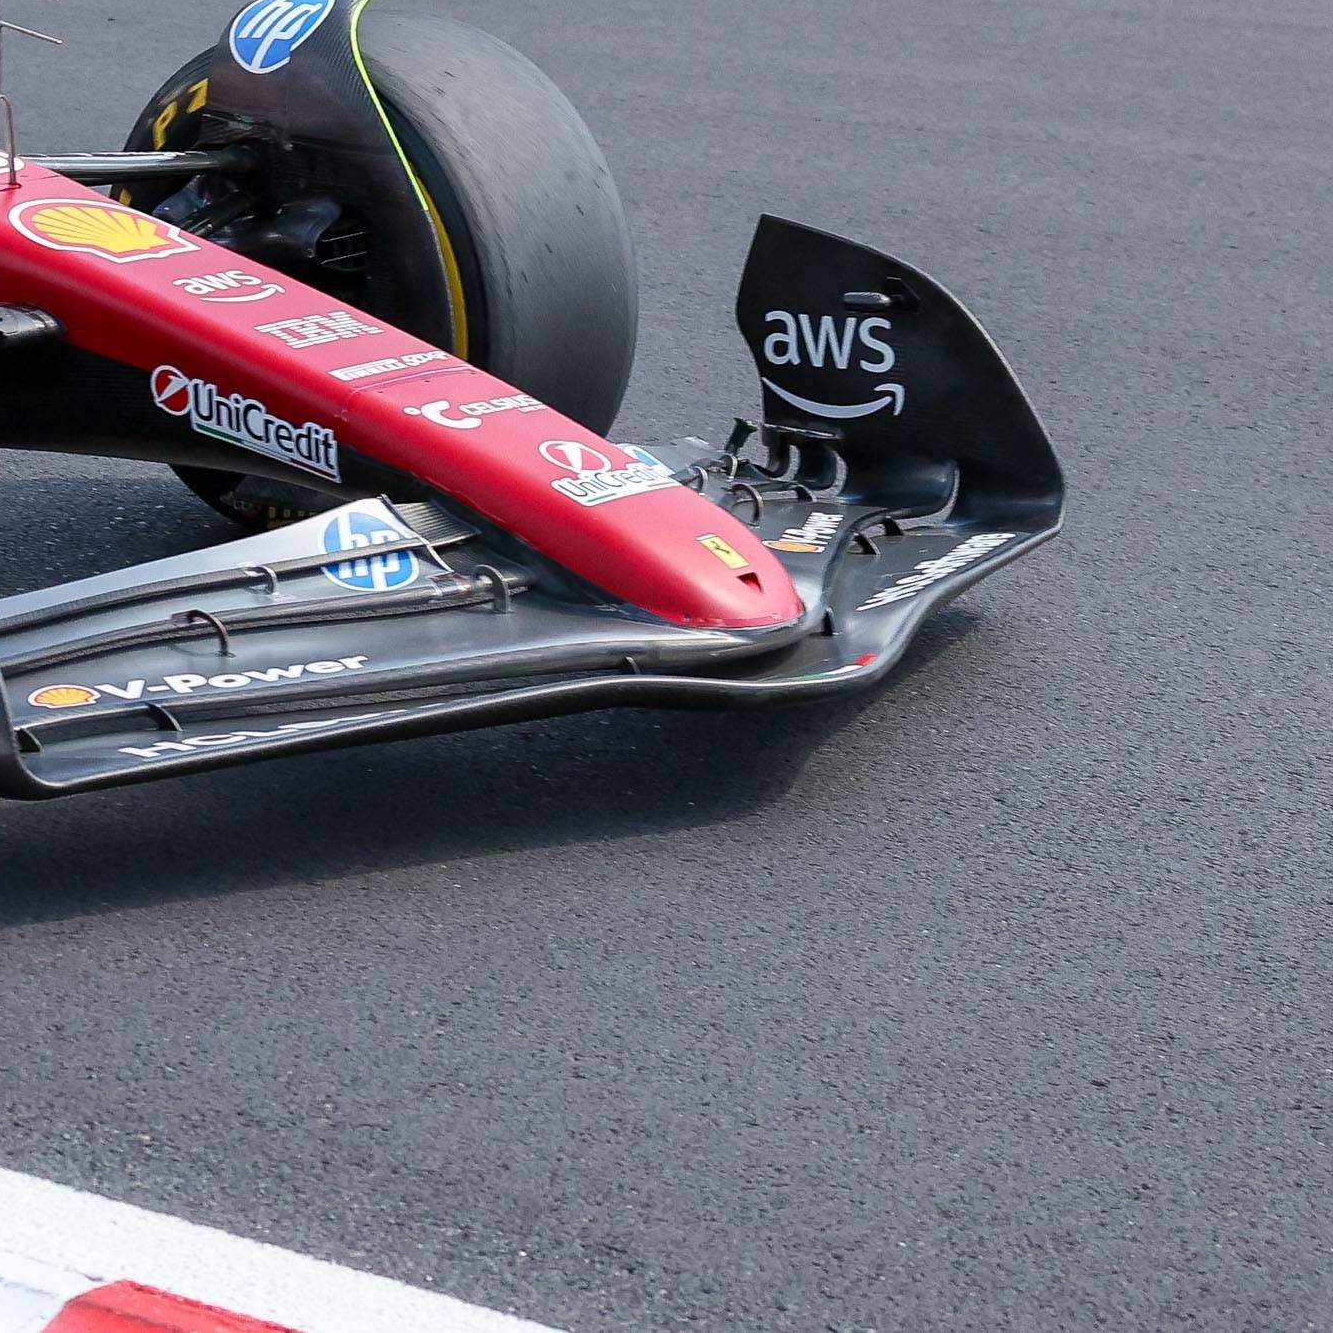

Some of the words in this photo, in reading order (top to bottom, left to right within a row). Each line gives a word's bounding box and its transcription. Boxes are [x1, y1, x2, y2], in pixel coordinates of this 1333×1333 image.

[173, 270, 264, 297] aws
[254, 311, 383, 349] IBM
[763, 309, 896, 374] aws
[192, 379, 339, 472] UniCredit
[96, 654, 370, 701] V-Power
